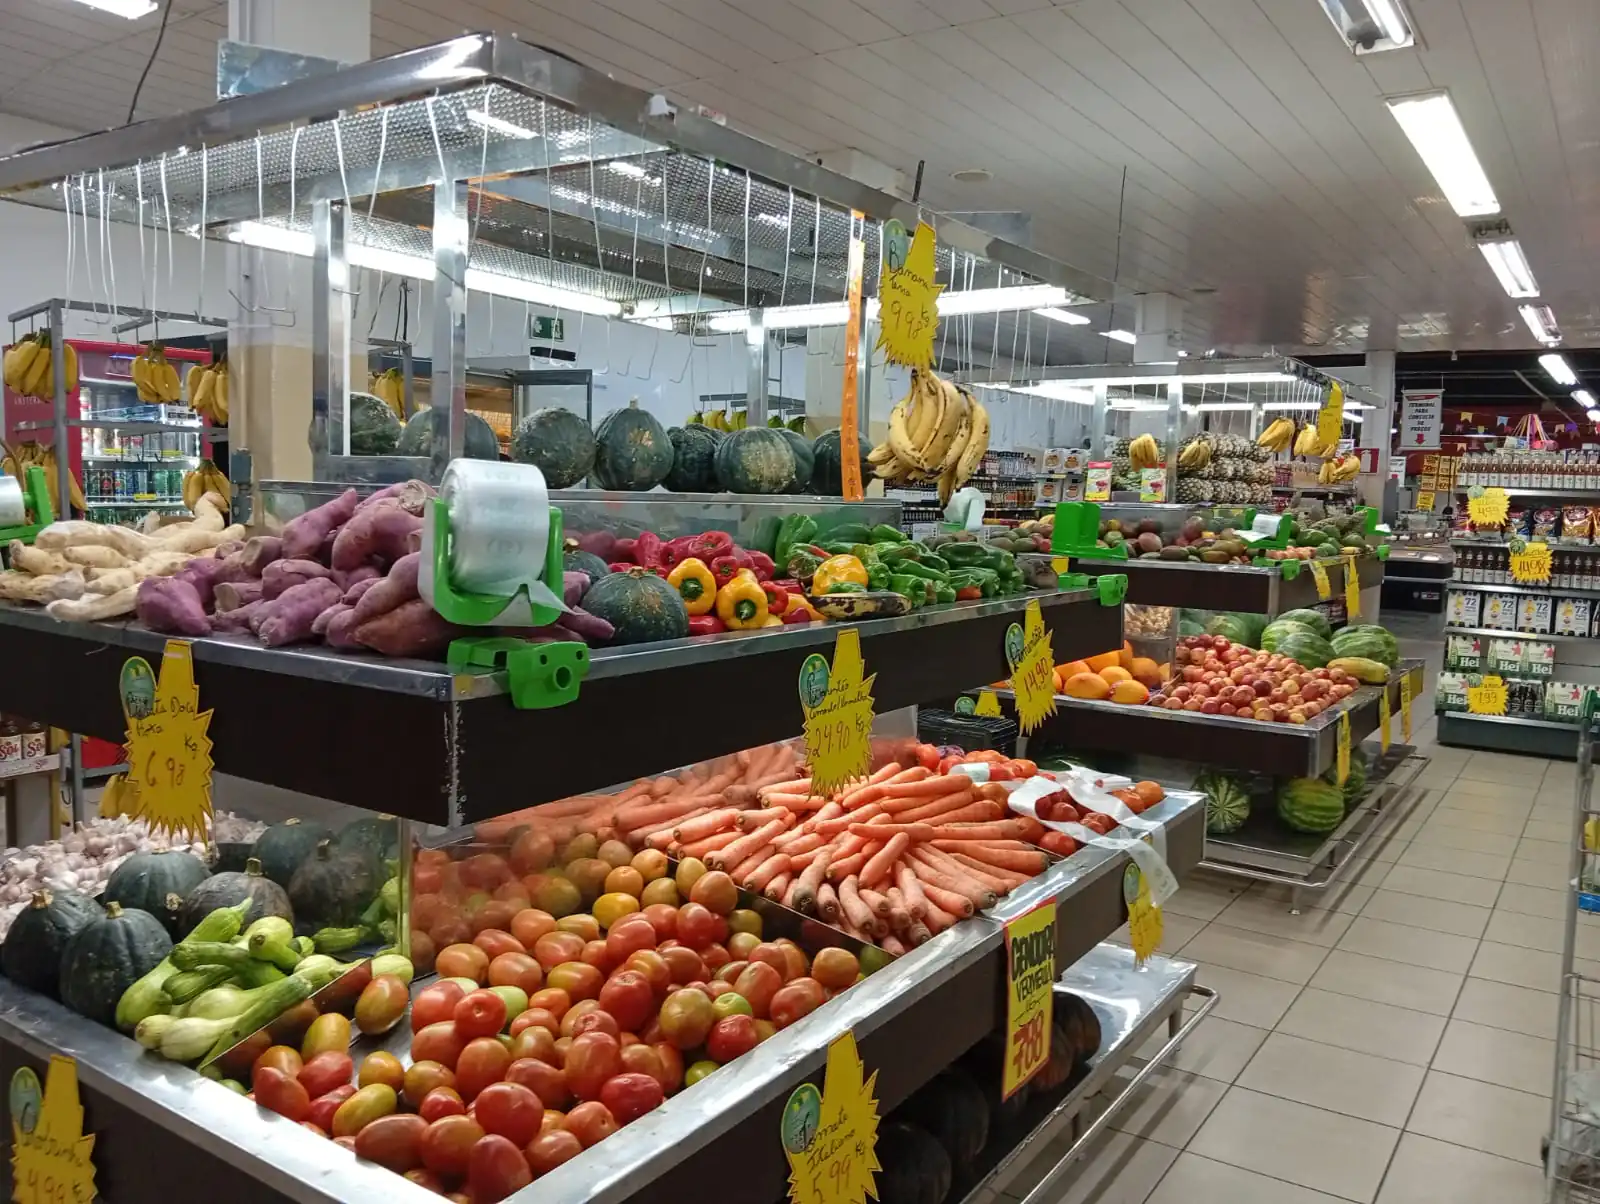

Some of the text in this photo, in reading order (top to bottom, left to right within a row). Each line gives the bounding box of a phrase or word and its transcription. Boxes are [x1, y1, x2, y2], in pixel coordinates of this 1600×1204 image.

[888, 239, 930, 292] Banana
[1465, 597, 1477, 607] 72
[1501, 600, 1514, 609] 72
[1536, 603, 1549, 612] 72
[1574, 605, 1588, 615] 72
[1460, 657, 1480, 668] Hei
[1499, 660, 1520, 672] Hei
[1532, 663, 1553, 675] Hei
[1557, 705, 1579, 717] Hei
